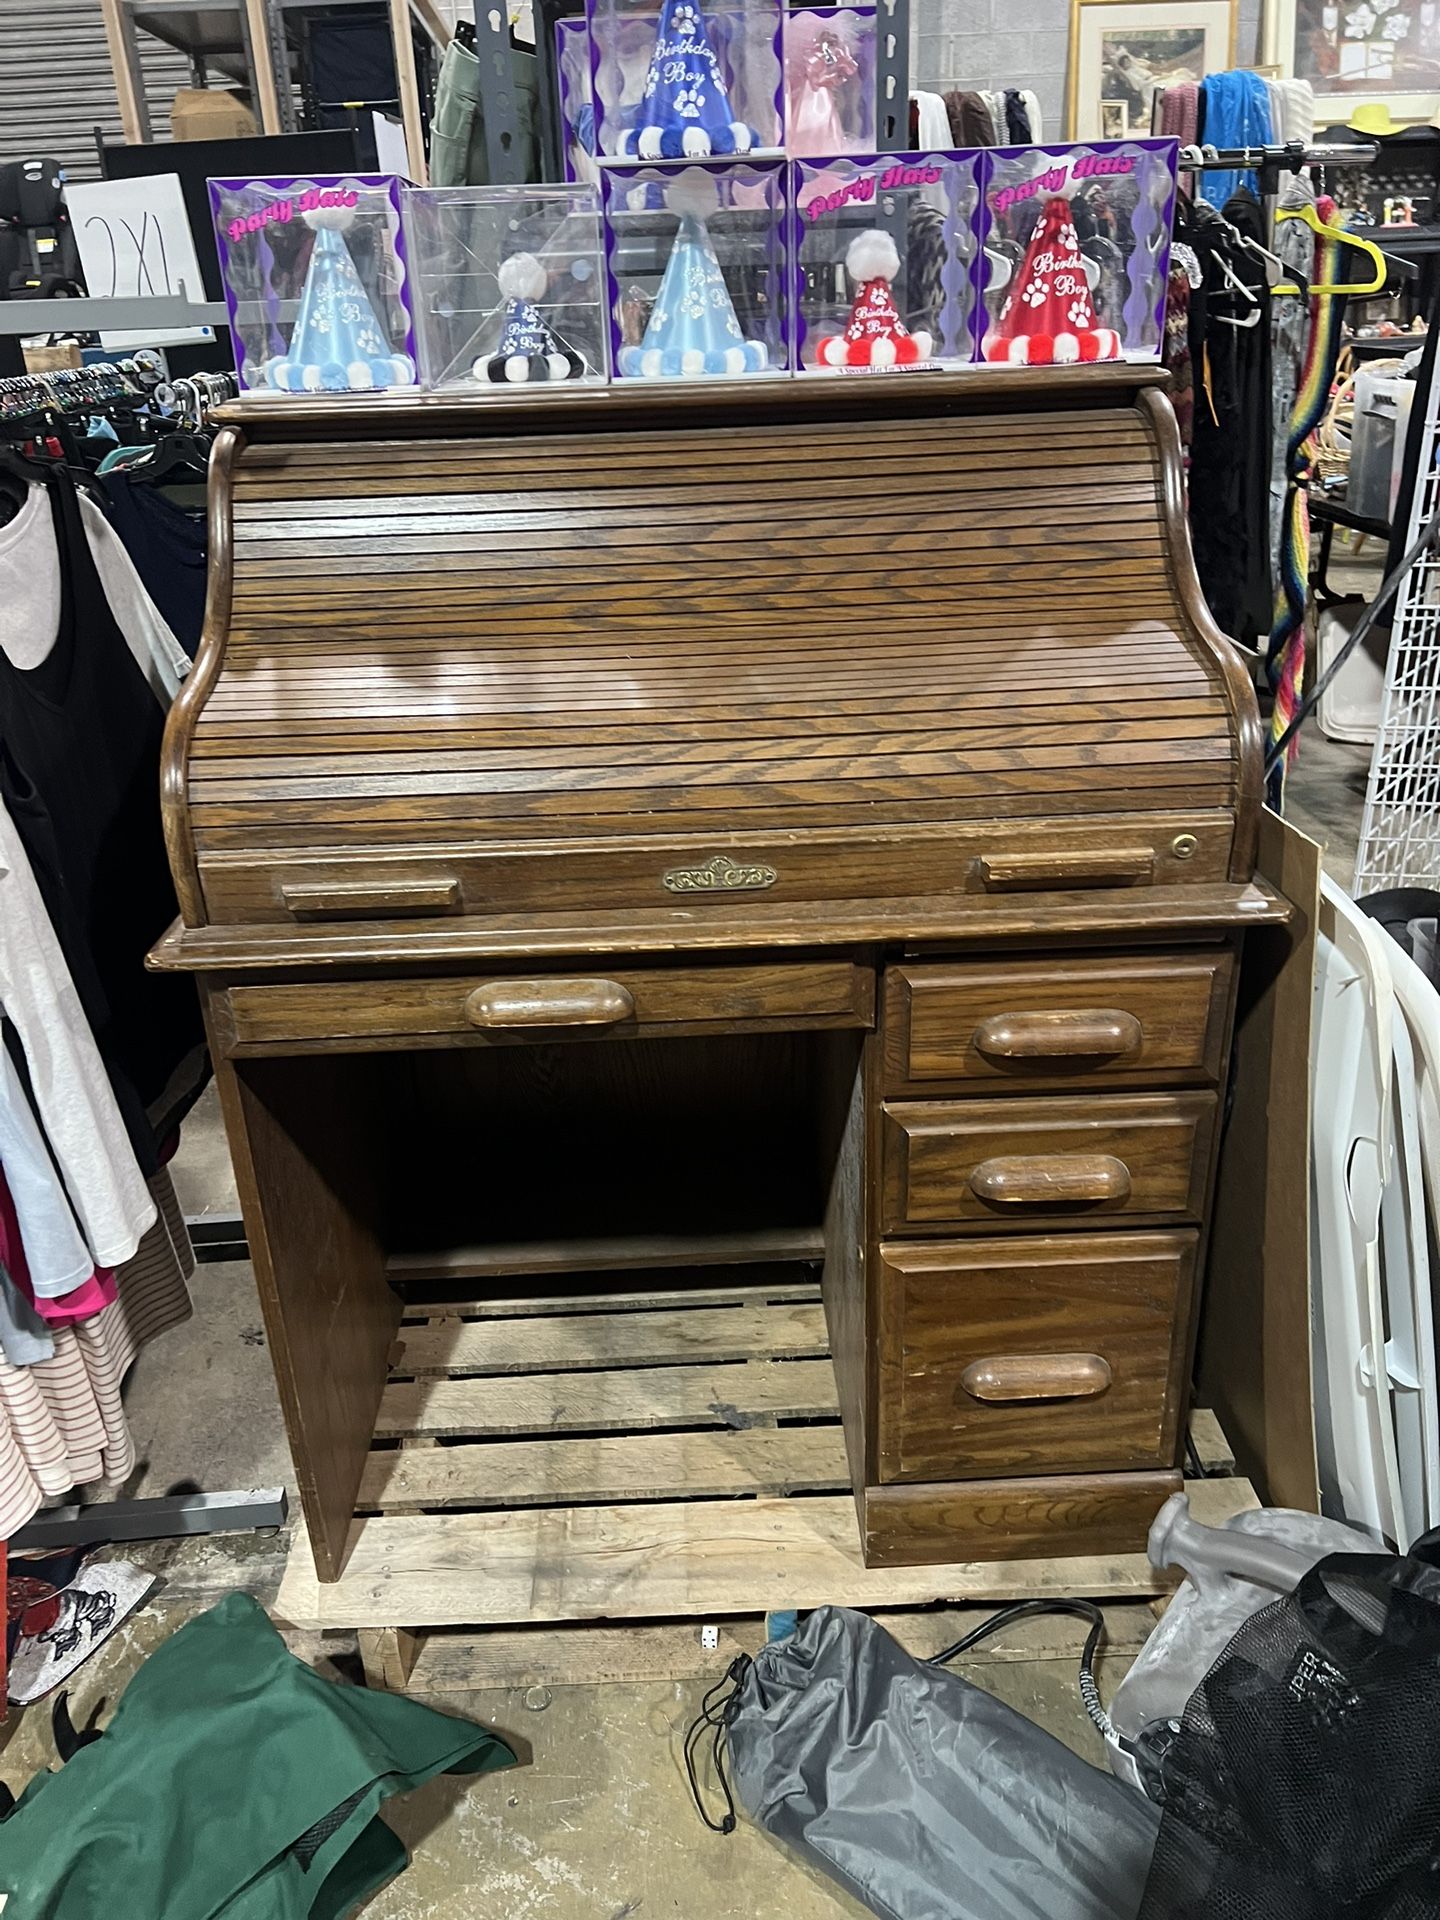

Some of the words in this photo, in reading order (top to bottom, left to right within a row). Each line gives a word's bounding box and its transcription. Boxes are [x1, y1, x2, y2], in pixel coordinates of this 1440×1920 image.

[652, 36, 717, 67] Birthday
[663, 61, 706, 90] Boy
[805, 176, 876, 223] Party
[880, 162, 943, 190] Hats
[993, 165, 1068, 213] Party
[1071, 152, 1137, 180] Hats
[228, 197, 293, 243] Party
[298, 186, 359, 212] Hats
[1053, 274, 1089, 302] Boy
[866, 319, 893, 338] Boy
[519, 336, 545, 353] Boy
